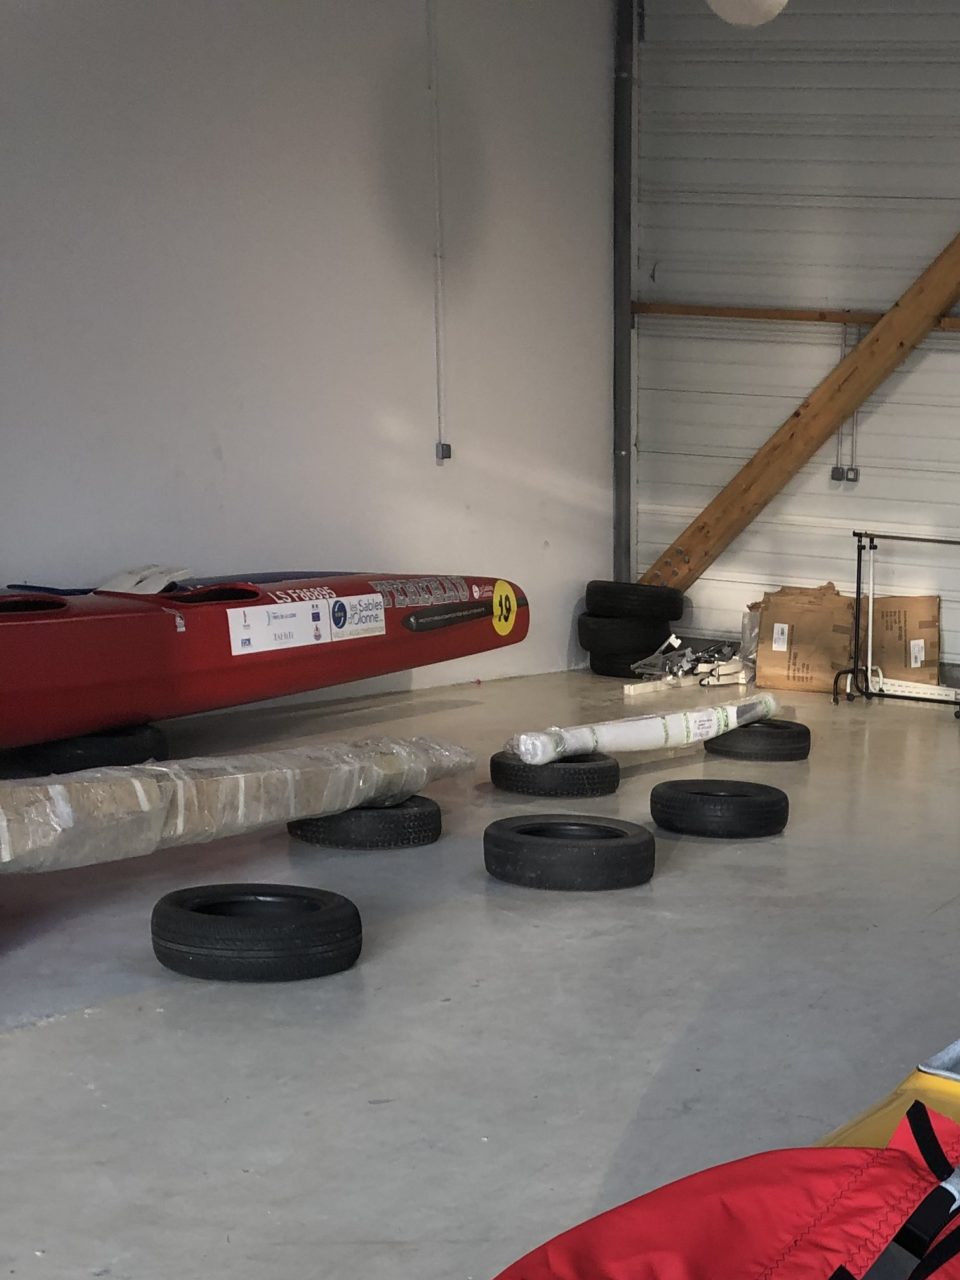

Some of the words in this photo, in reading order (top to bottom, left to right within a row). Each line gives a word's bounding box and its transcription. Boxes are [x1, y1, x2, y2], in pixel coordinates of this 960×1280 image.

[268, 590, 291, 603] LS
[358, 598, 383, 613] Sables
[498, 594, 512, 623] 19
